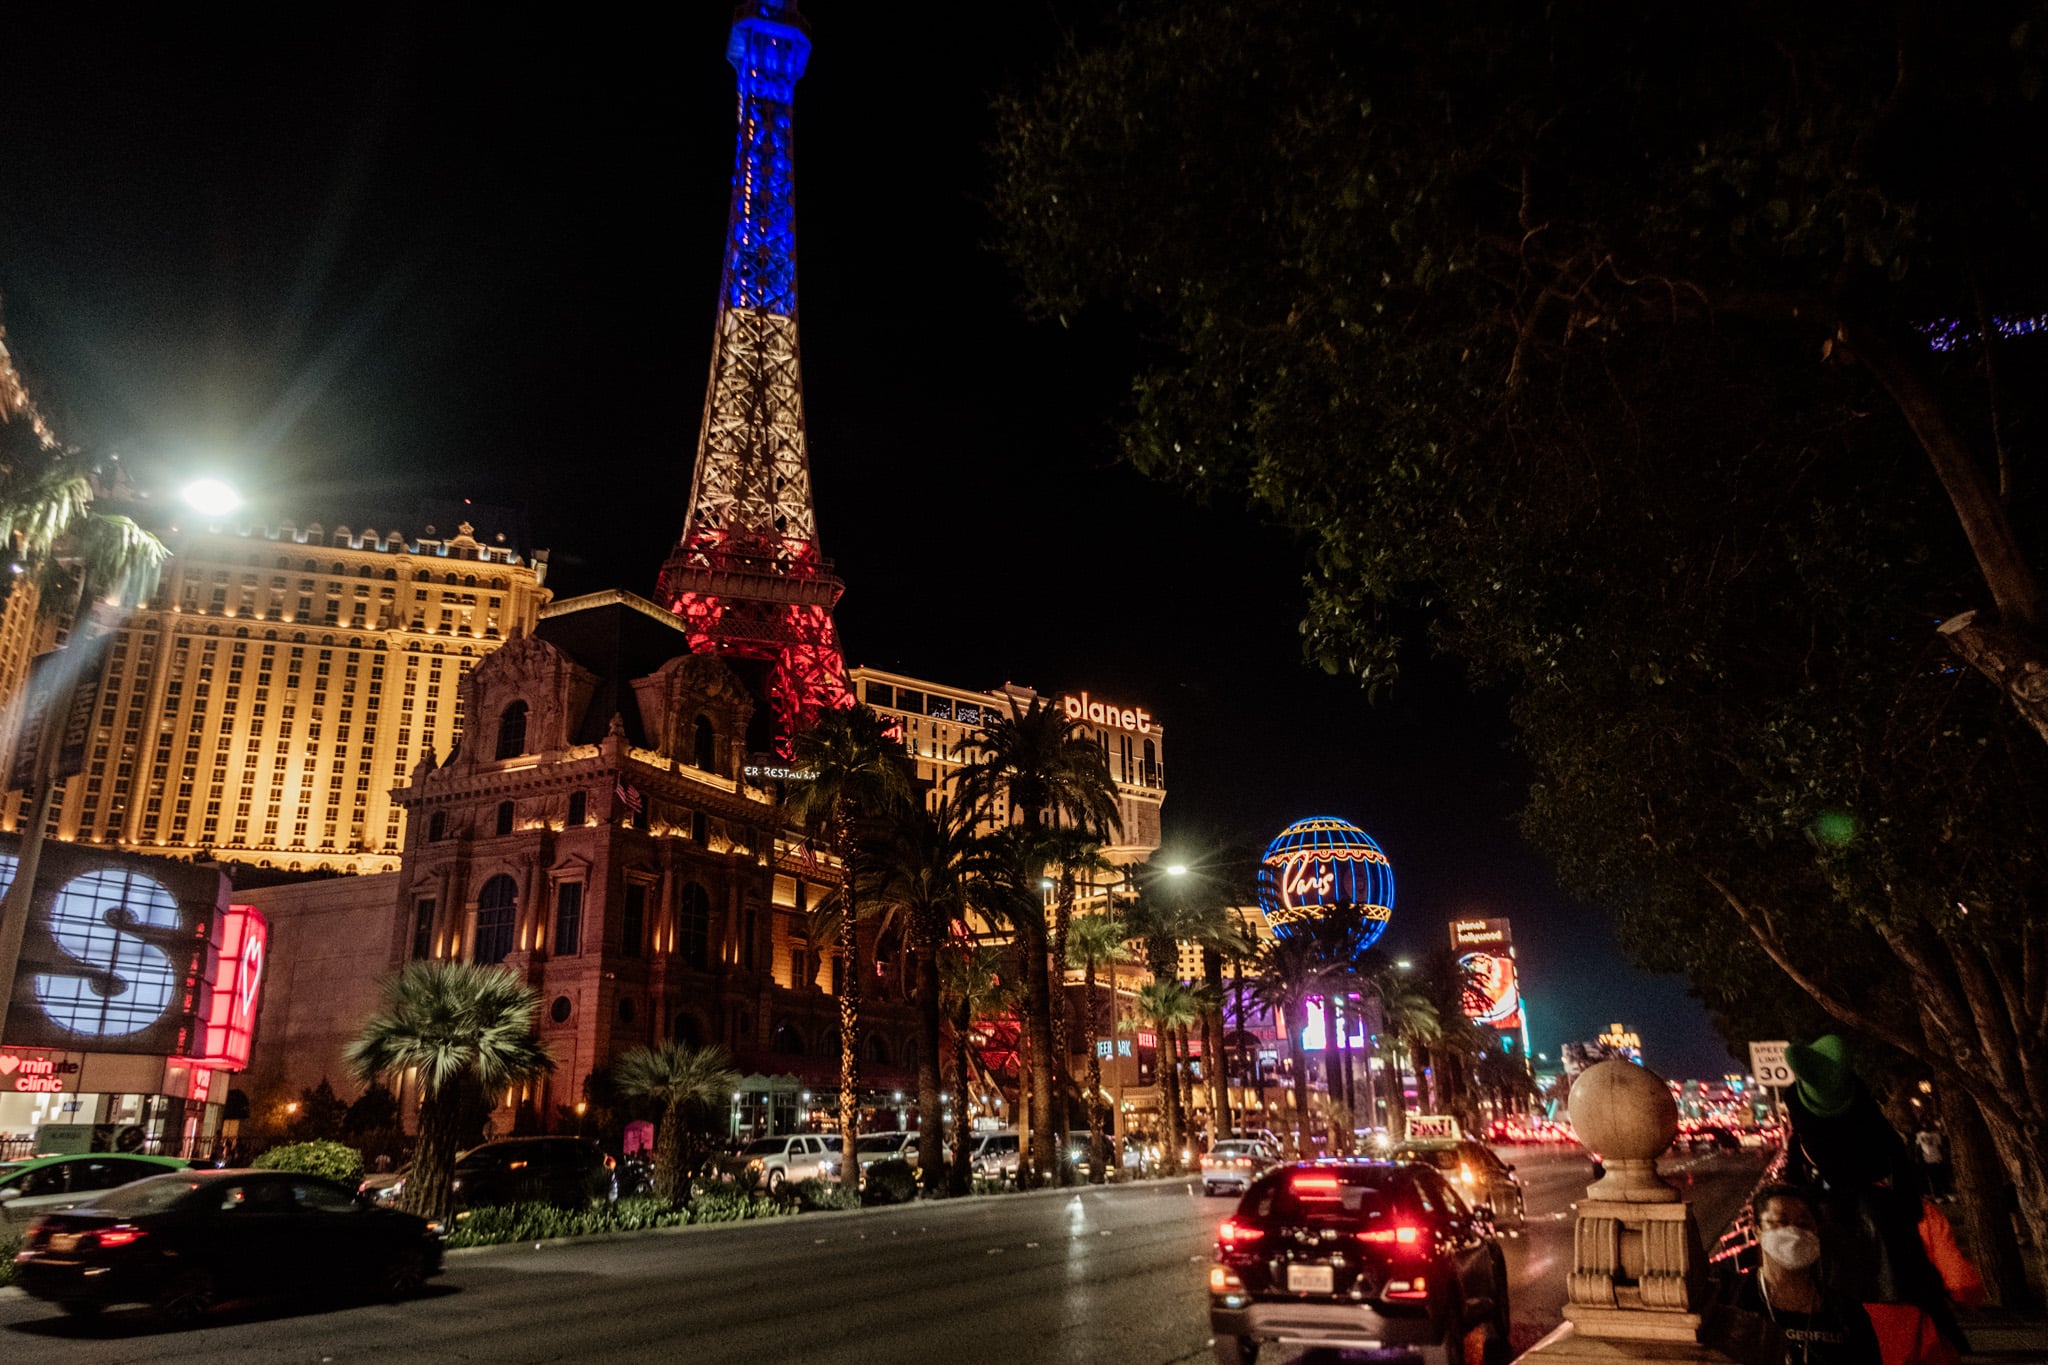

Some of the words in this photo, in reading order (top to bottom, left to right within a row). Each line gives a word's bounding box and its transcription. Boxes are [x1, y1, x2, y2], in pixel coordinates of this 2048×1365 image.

[1064, 691, 1150, 733] planet
[1282, 849, 1334, 918] Paris
[20, 1056, 79, 1074] minute
[1759, 1066, 1788, 1080] 30
[15, 1074, 63, 1092] clinic
